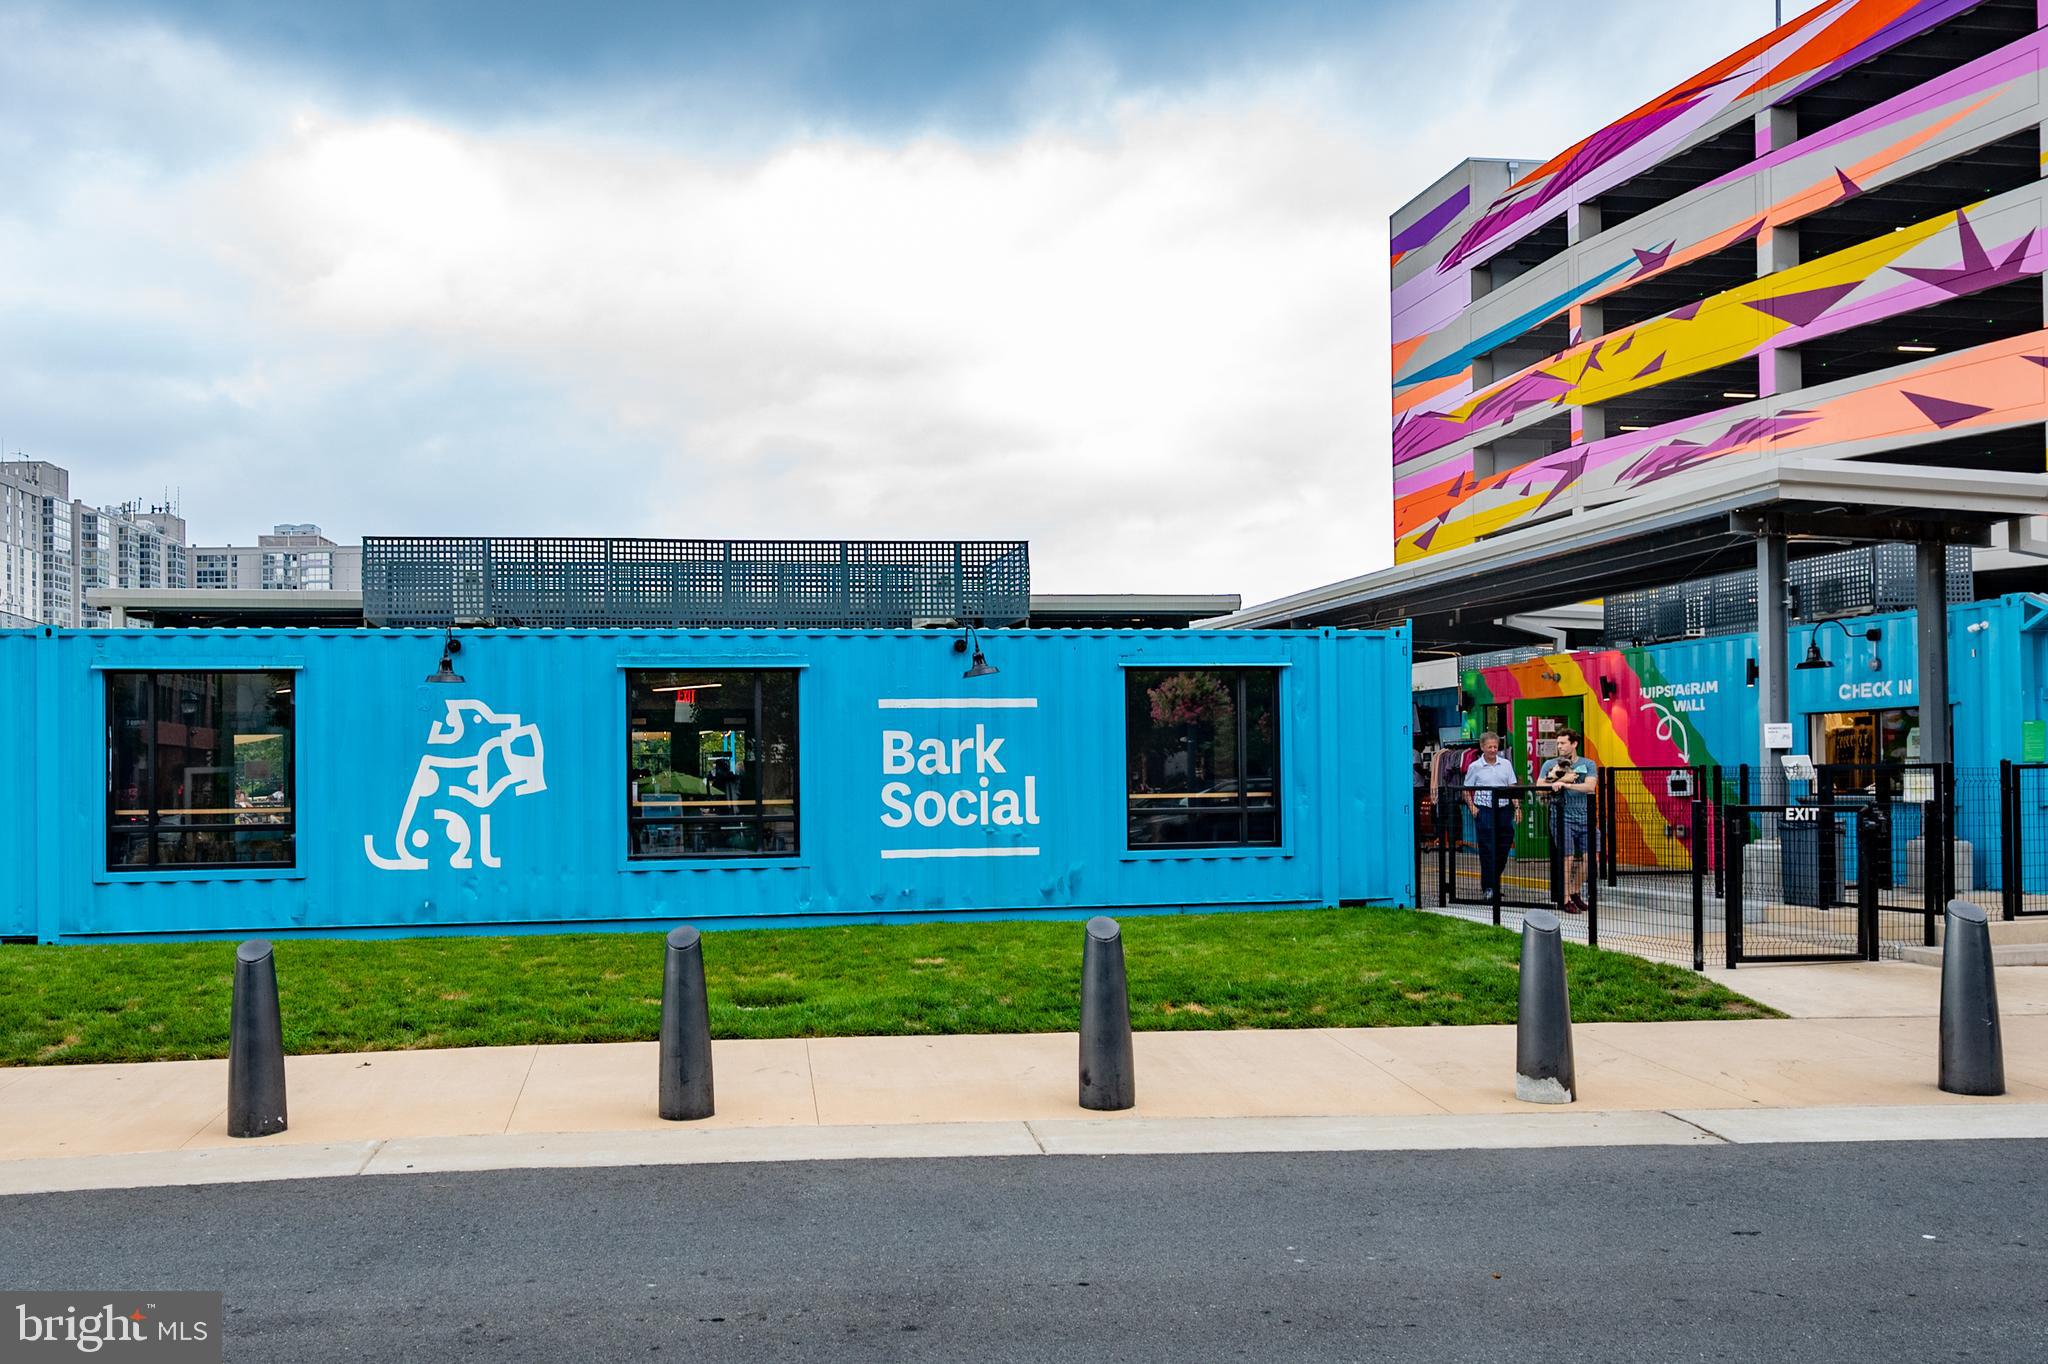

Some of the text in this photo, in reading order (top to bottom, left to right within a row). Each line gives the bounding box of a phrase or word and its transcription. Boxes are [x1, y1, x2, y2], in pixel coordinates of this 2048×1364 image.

[676, 689, 696, 703] EXIT
[1839, 679, 1912, 700] CHECK IN
[1673, 698, 1706, 713] WALL
[882, 724, 1007, 775] Bark
[880, 776, 1040, 828] Social
[1785, 807, 1820, 821] EXIT
